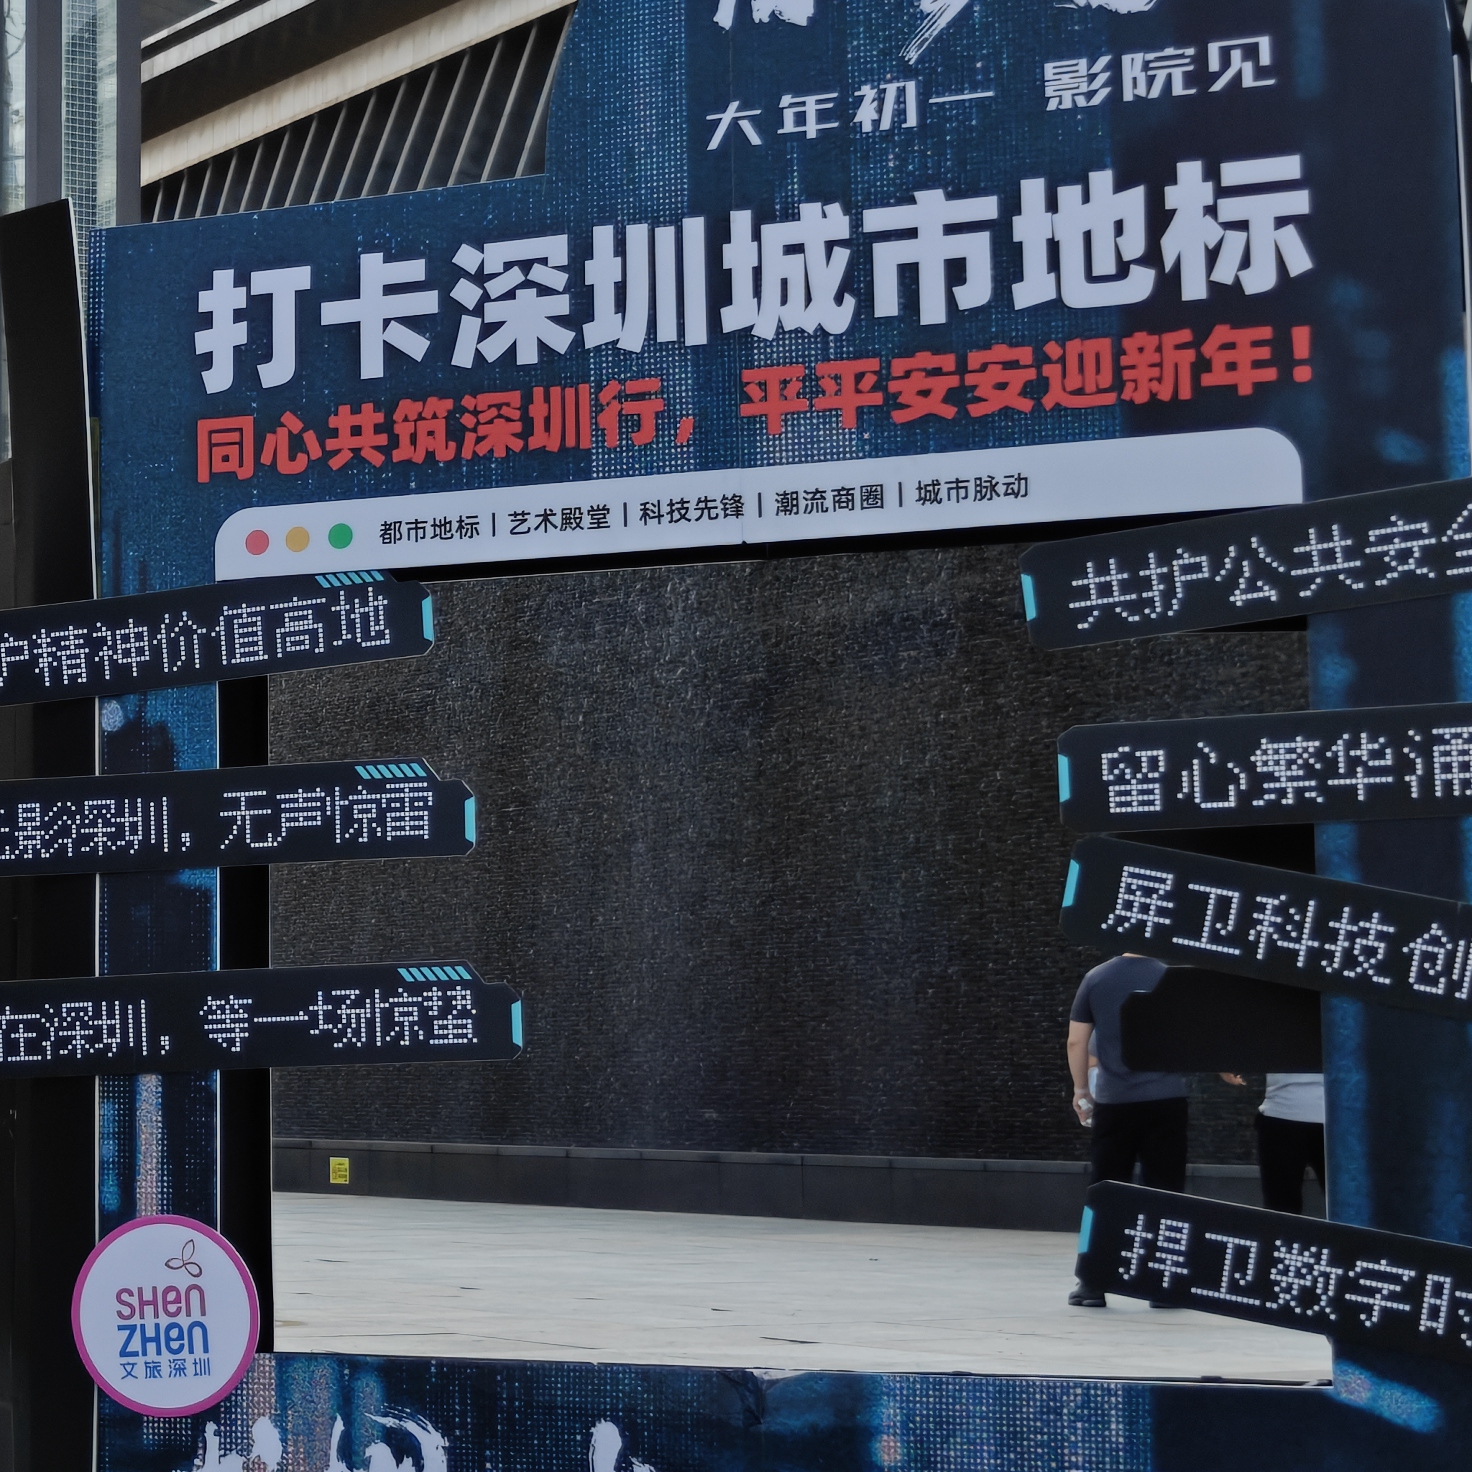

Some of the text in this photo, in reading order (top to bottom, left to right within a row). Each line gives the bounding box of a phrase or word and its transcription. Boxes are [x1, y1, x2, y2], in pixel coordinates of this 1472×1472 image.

[706, 35, 1277, 151] 大年初一 影院见
[195, 156, 1312, 395] 打卡深圳城市地标
[119, 1357, 211, 1380] 文旅深圳
